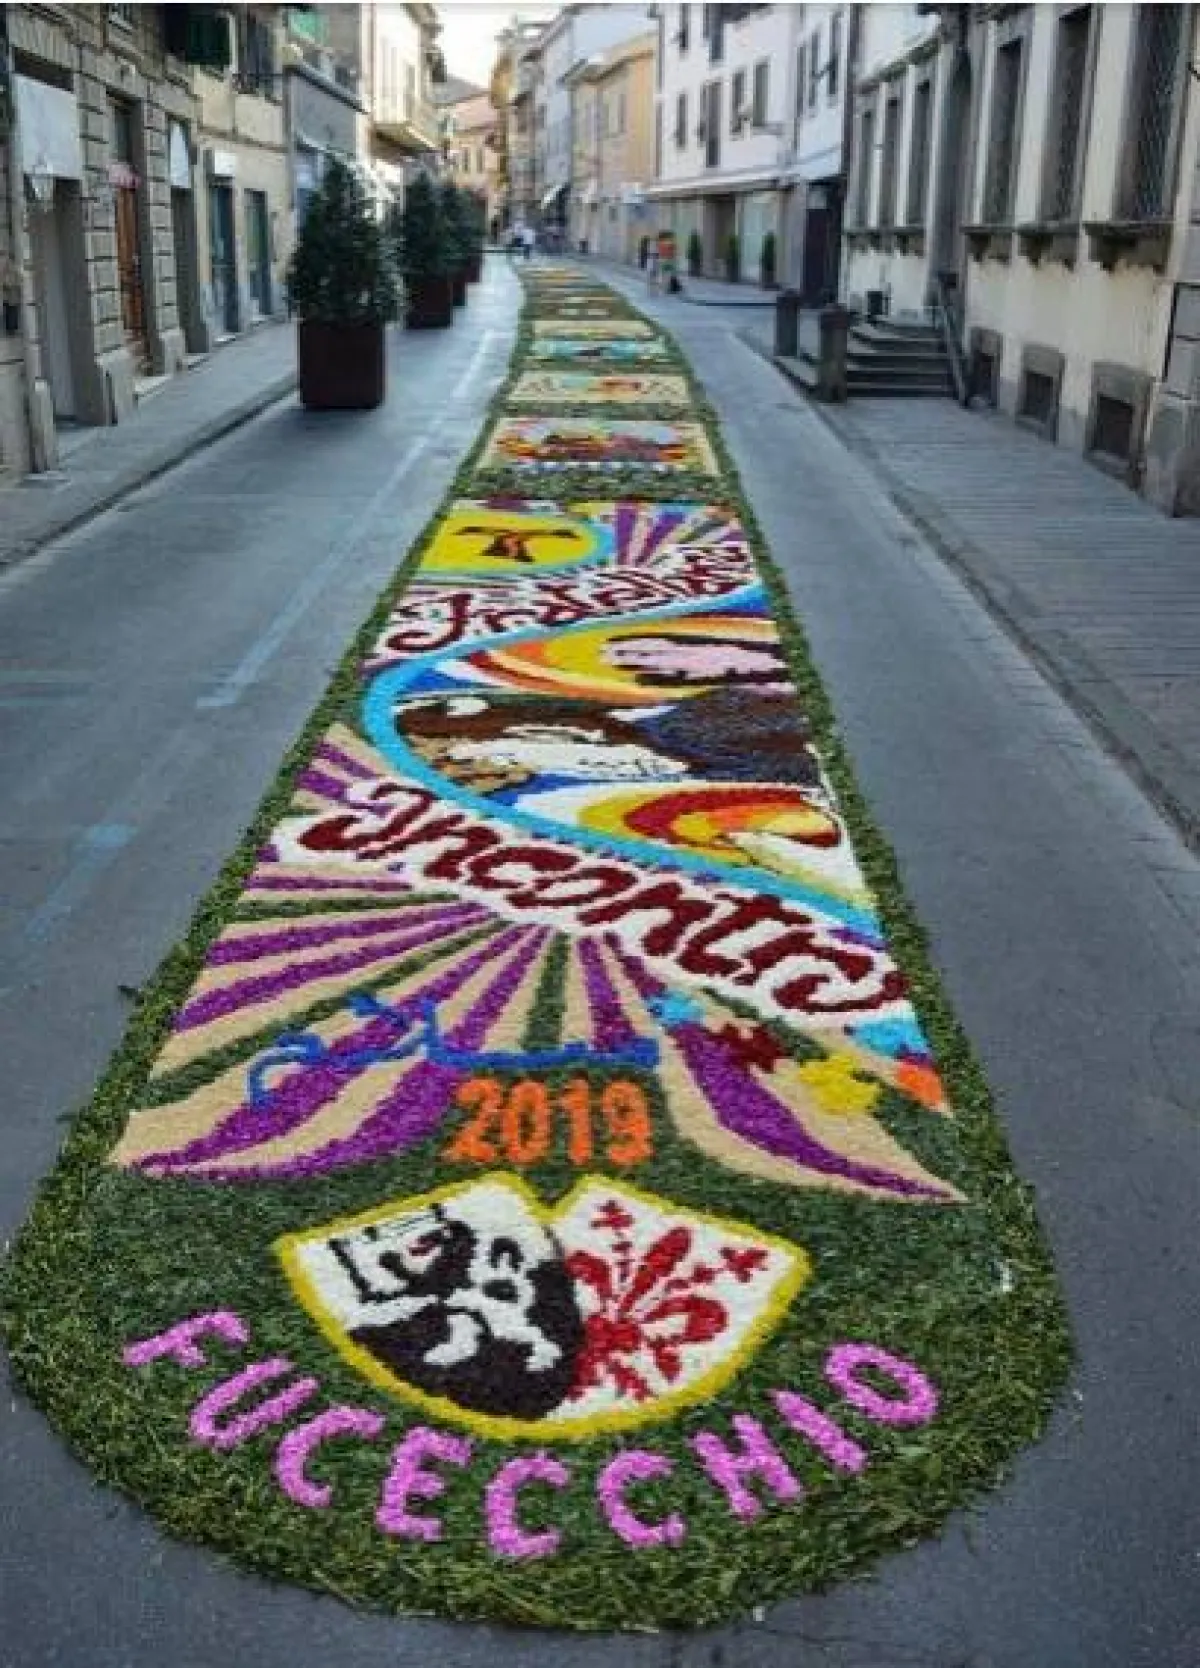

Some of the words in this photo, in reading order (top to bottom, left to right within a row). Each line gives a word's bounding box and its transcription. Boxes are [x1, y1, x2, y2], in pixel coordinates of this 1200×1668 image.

[300, 785, 911, 1012] Incontro
[446, 1077, 653, 1166] 2019
[123, 1310, 940, 1558] FUCECCHIO
